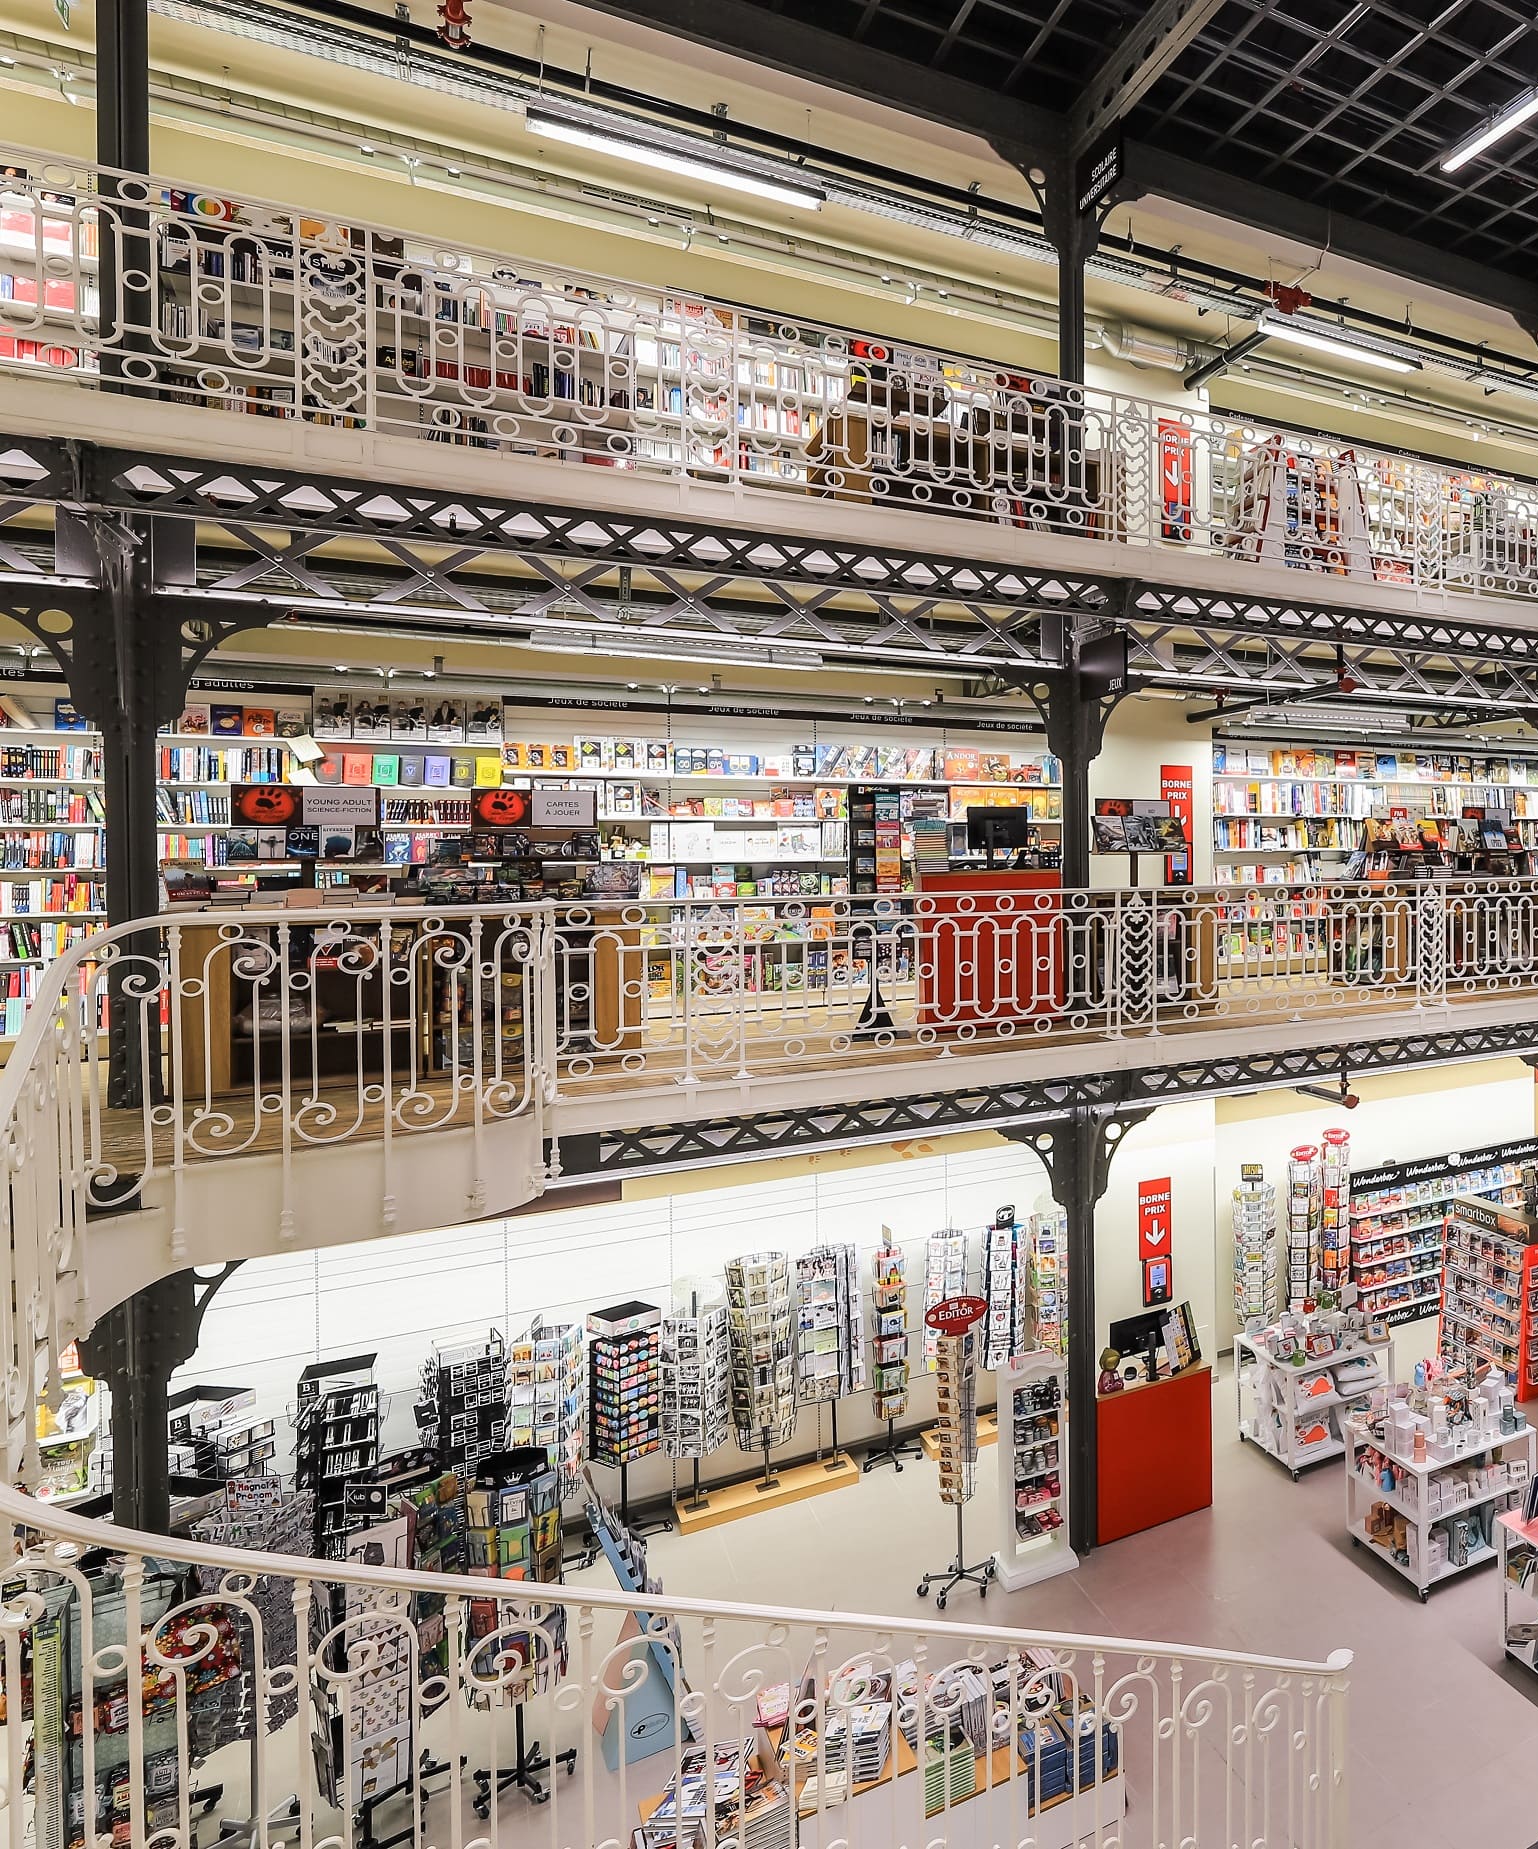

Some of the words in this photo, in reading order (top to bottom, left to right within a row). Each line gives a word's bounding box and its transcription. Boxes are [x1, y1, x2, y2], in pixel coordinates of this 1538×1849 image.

[1092, 147, 1116, 181] SCOLAIRE
[1080, 164, 1116, 209] UNIVERSITAIRE
[1228, 412, 1255, 423] Cadeaux
[1108, 677, 1122, 691] JEUX
[977, 720, 994, 728] Jeux
[996, 721, 1005, 729] de
[1007, 722, 1033, 731] société
[947, 753, 977, 761] ANDOR
[1162, 780, 1192, 788] BORNE
[289, 832, 319, 841] ONE
[1501, 1145, 1538, 1158] Wonderbox
[1457, 1152, 1496, 1167] Wonderbox
[1406, 1160, 1448, 1177] Wonderbox
[1353, 1171, 1397, 1187] Wonderbox
[1140, 1192, 1170, 1205] BORNE
[1145, 1204, 1165, 1216] PRIX
[1454, 1203, 1496, 1227] smartbox
[939, 1306, 973, 1320] EDITOR
[346, 1489, 366, 1504] Kiub
